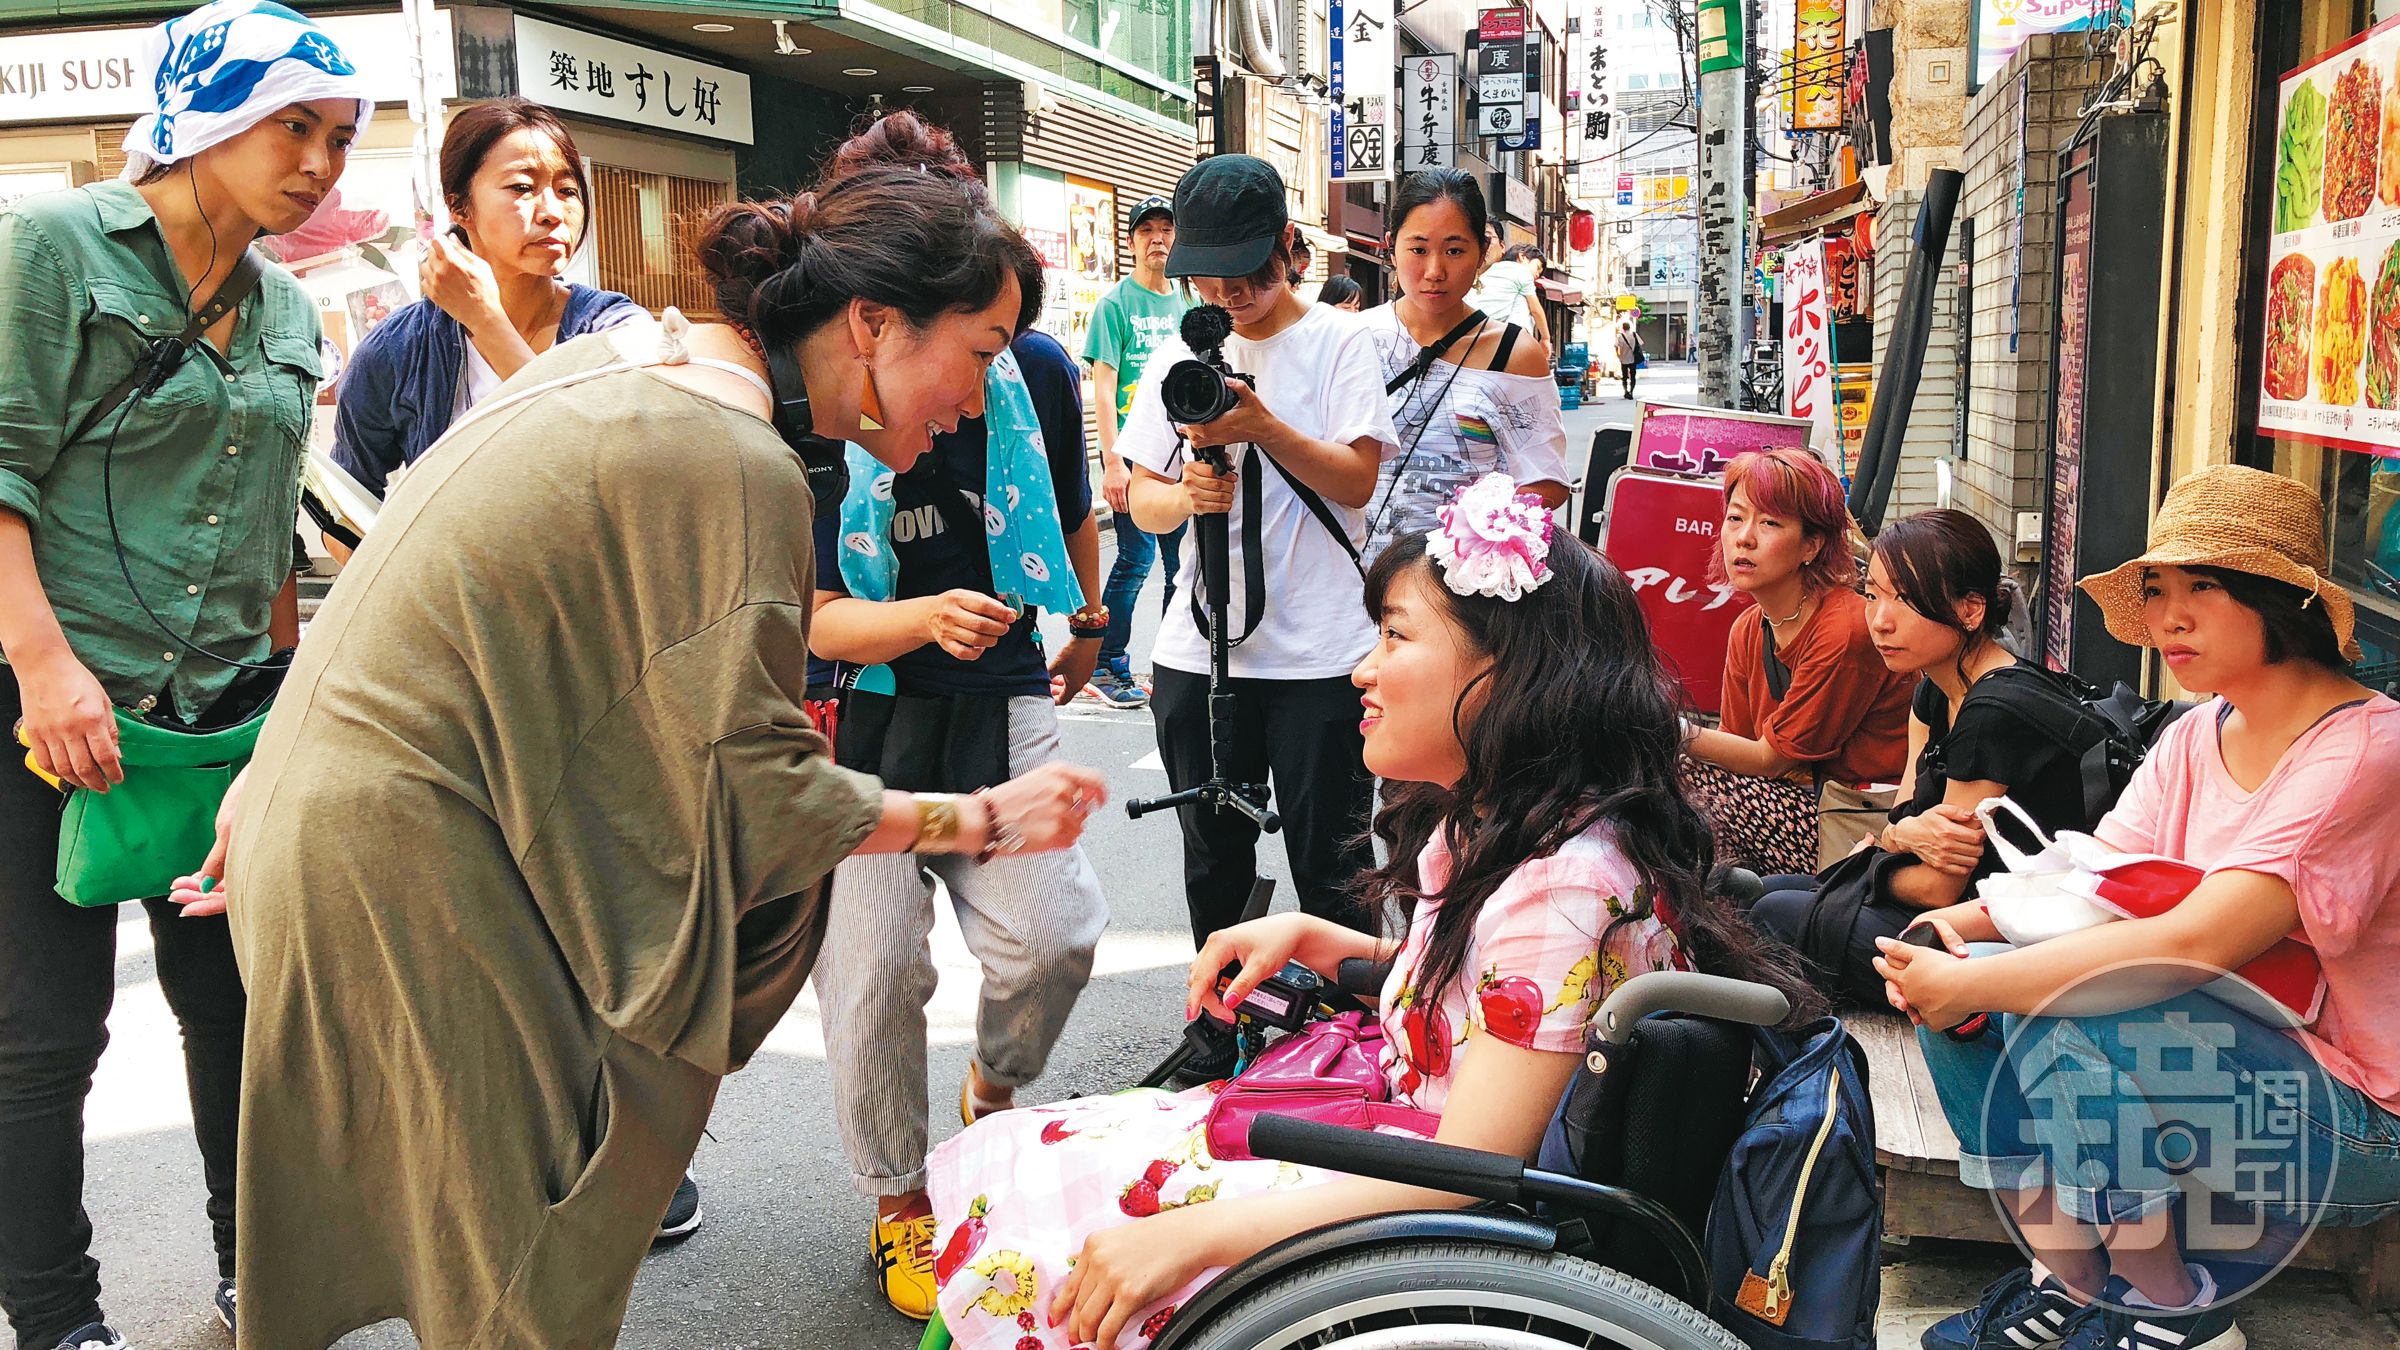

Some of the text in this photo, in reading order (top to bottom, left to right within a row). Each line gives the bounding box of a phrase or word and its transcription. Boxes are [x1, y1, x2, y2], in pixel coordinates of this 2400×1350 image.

[1345, 9, 1384, 42] 金
[1482, 88, 1520, 99] くまがい
[1675, 518, 1713, 536] BAR
